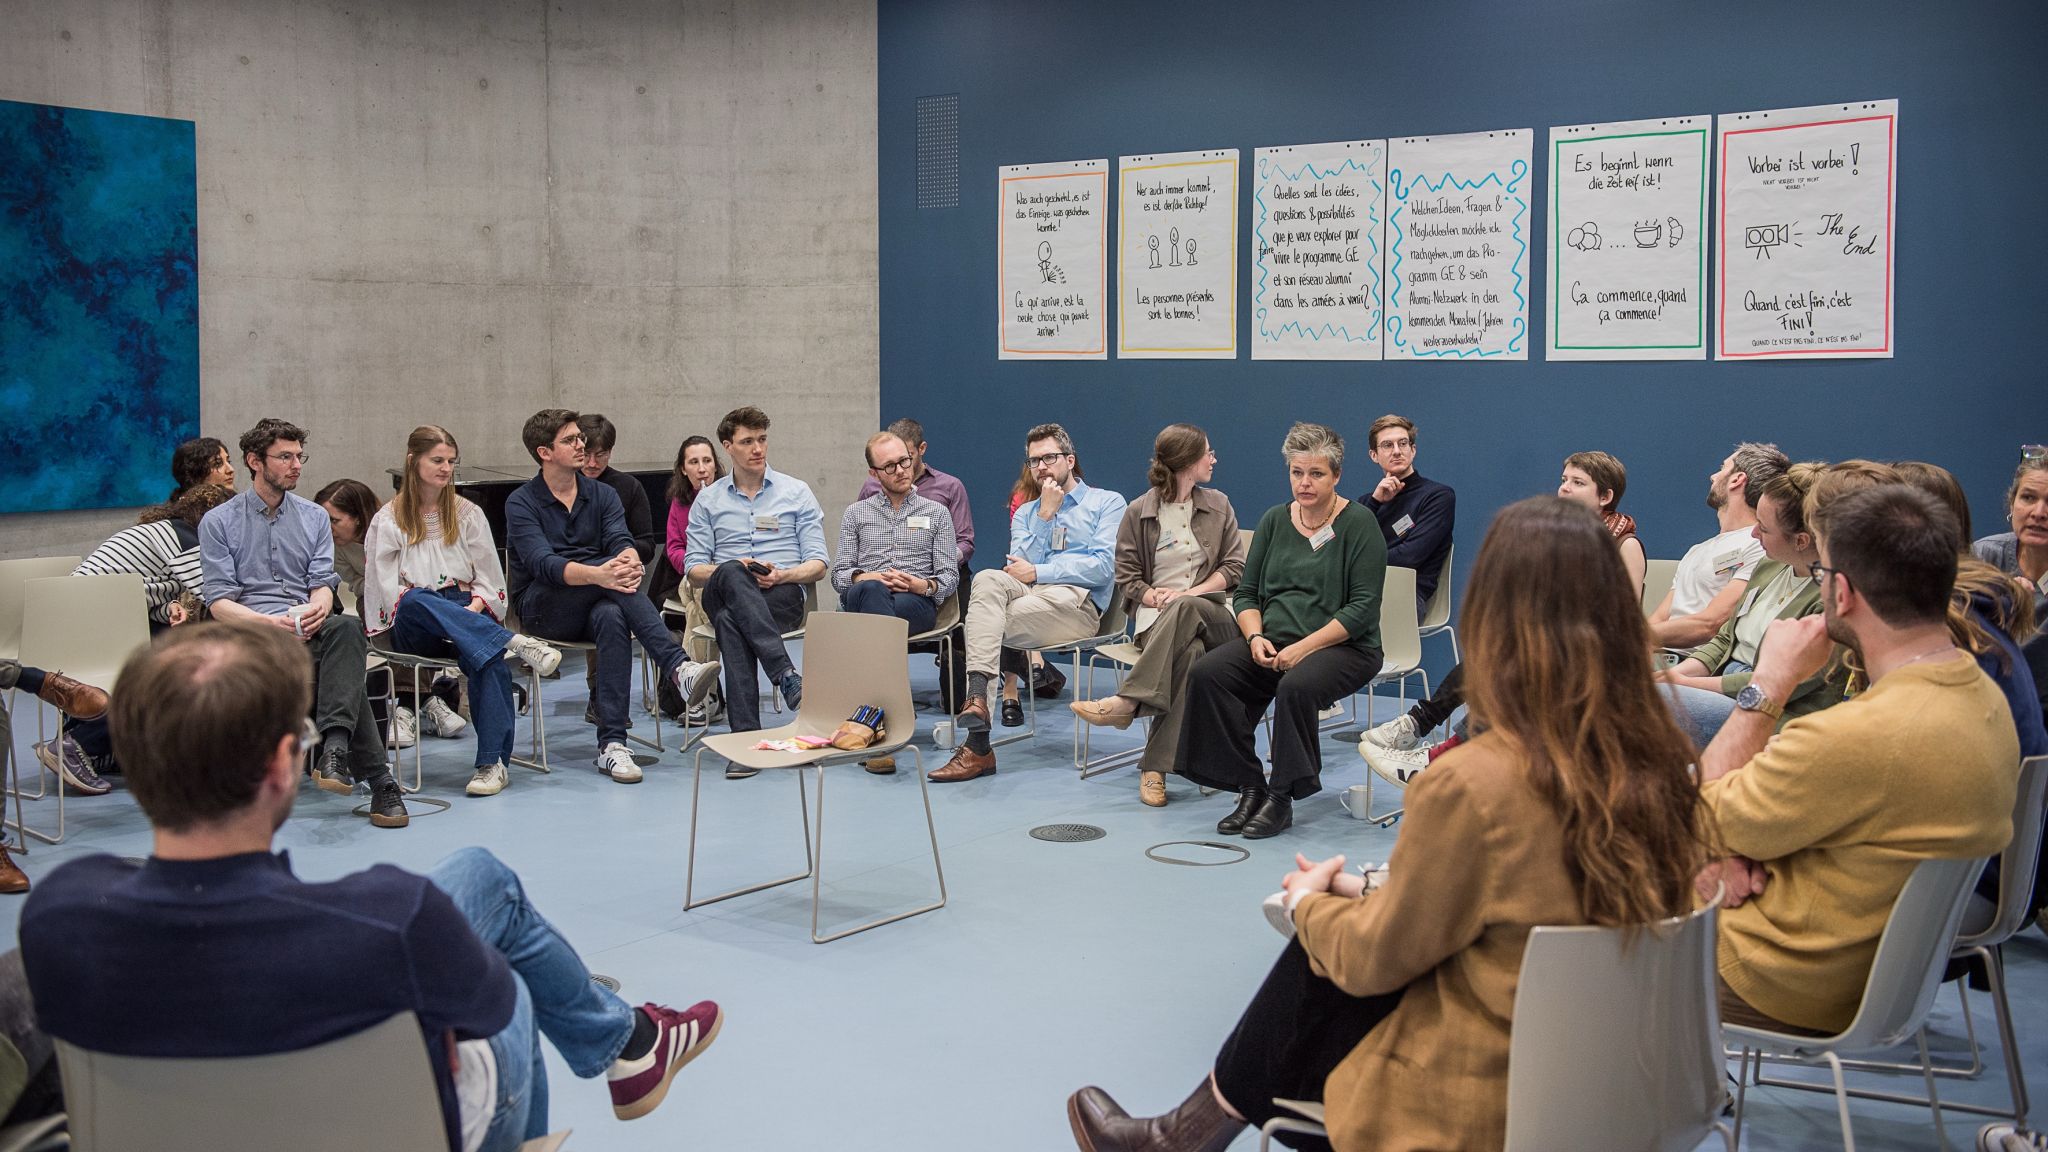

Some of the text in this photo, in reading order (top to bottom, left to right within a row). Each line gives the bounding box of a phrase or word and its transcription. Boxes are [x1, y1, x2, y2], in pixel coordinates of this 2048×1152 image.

[1575, 151, 1673, 176] Es beginnt wenn
[1747, 155, 1783, 174] Vorbei
[1789, 150, 1805, 171] ist
[1136, 175, 1216, 196] Wer auch immer kommt,
[1273, 182, 1360, 200] Quelles sont les idées,
[1588, 176, 1604, 190] die
[1606, 174, 1623, 188] Zeit
[1625, 174, 1640, 192] reif
[1030, 192, 1043, 204] auch
[1081, 190, 1091, 201] ist
[1143, 203, 1150, 211] es
[1152, 199, 1161, 211] ist
[1411, 195, 1503, 216] Welchen Ideen, Fragen &
[1015, 209, 1026, 219] das
[1053, 209, 1064, 217] was
[1065, 205, 1090, 219] geschehen
[1273, 204, 1355, 225] questions & possibilités
[1410, 221, 1502, 241] Möglichkeiten möchte ich
[1817, 213, 1844, 235] The
[1272, 228, 1360, 247] que je veux explorer pour
[1843, 225, 1877, 255] End
[1258, 239, 1274, 262] faire
[1273, 246, 1360, 268] vivre le programme GE
[1452, 249, 1464, 259] um
[1466, 246, 1480, 257] das
[1273, 272, 1352, 286] et son réseau alumni
[1408, 264, 1488, 287] gramm GE & sein
[1015, 290, 1024, 308] Ce
[1027, 297, 1039, 311] qui
[1064, 294, 1074, 307] est
[1076, 293, 1084, 306] la
[1136, 287, 1214, 308] Les personnes présentes
[1273, 293, 1293, 308] dans
[1297, 293, 1308, 307] les
[1338, 293, 1345, 306] à
[1409, 289, 1500, 305] Alumni-Netzwerk in den
[1571, 280, 1590, 306] Ça
[1657, 287, 1687, 307] quand
[1744, 289, 1781, 312] Quand
[1785, 293, 1807, 310] c'est
[1830, 289, 1853, 308] c'est
[1037, 312, 1056, 322] chose
[1060, 312, 1070, 325] qui
[1148, 309, 1161, 320] sont
[1164, 307, 1172, 320] les
[1408, 310, 1447, 327] kommenden
[1598, 309, 1611, 325] ça
[1752, 339, 1770, 347] QUAND
[1771, 338, 1778, 346] CE
